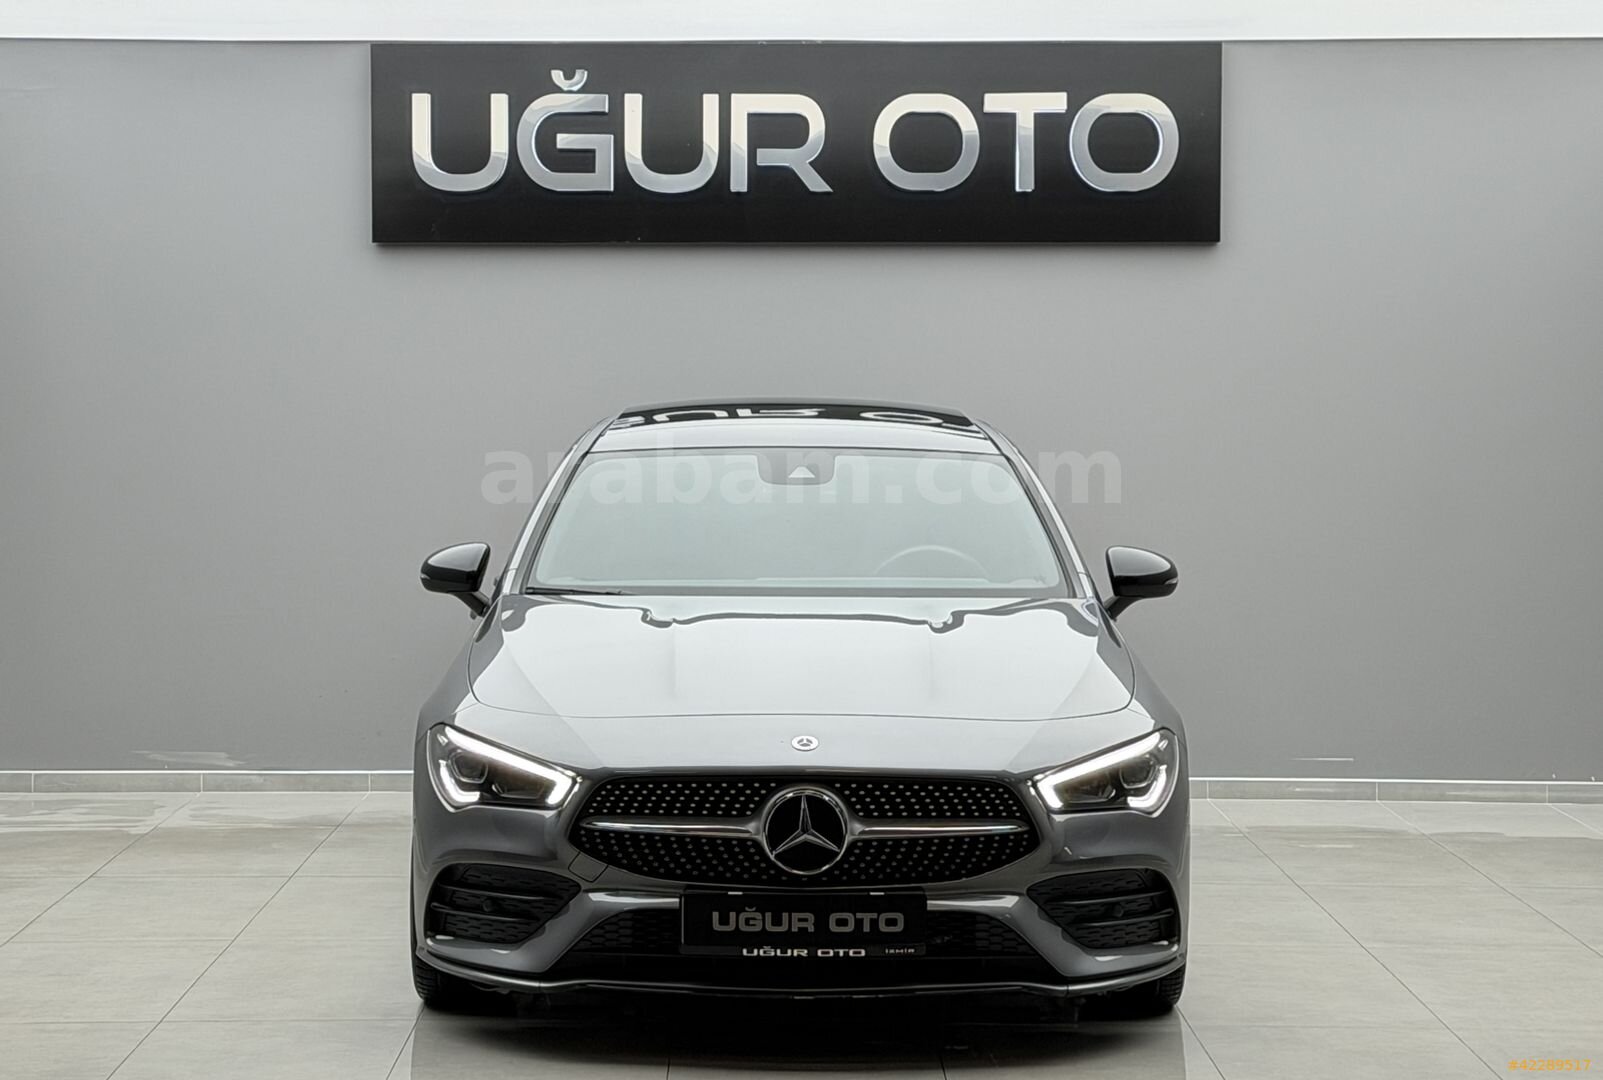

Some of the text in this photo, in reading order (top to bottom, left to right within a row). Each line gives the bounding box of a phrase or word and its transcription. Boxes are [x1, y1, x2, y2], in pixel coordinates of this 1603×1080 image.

[410, 68, 1181, 193] UĞUR OTO
[712, 906, 905, 932] UĞUR OTO
[742, 946, 808, 957] UĞUR
[817, 948, 866, 957] OTO
